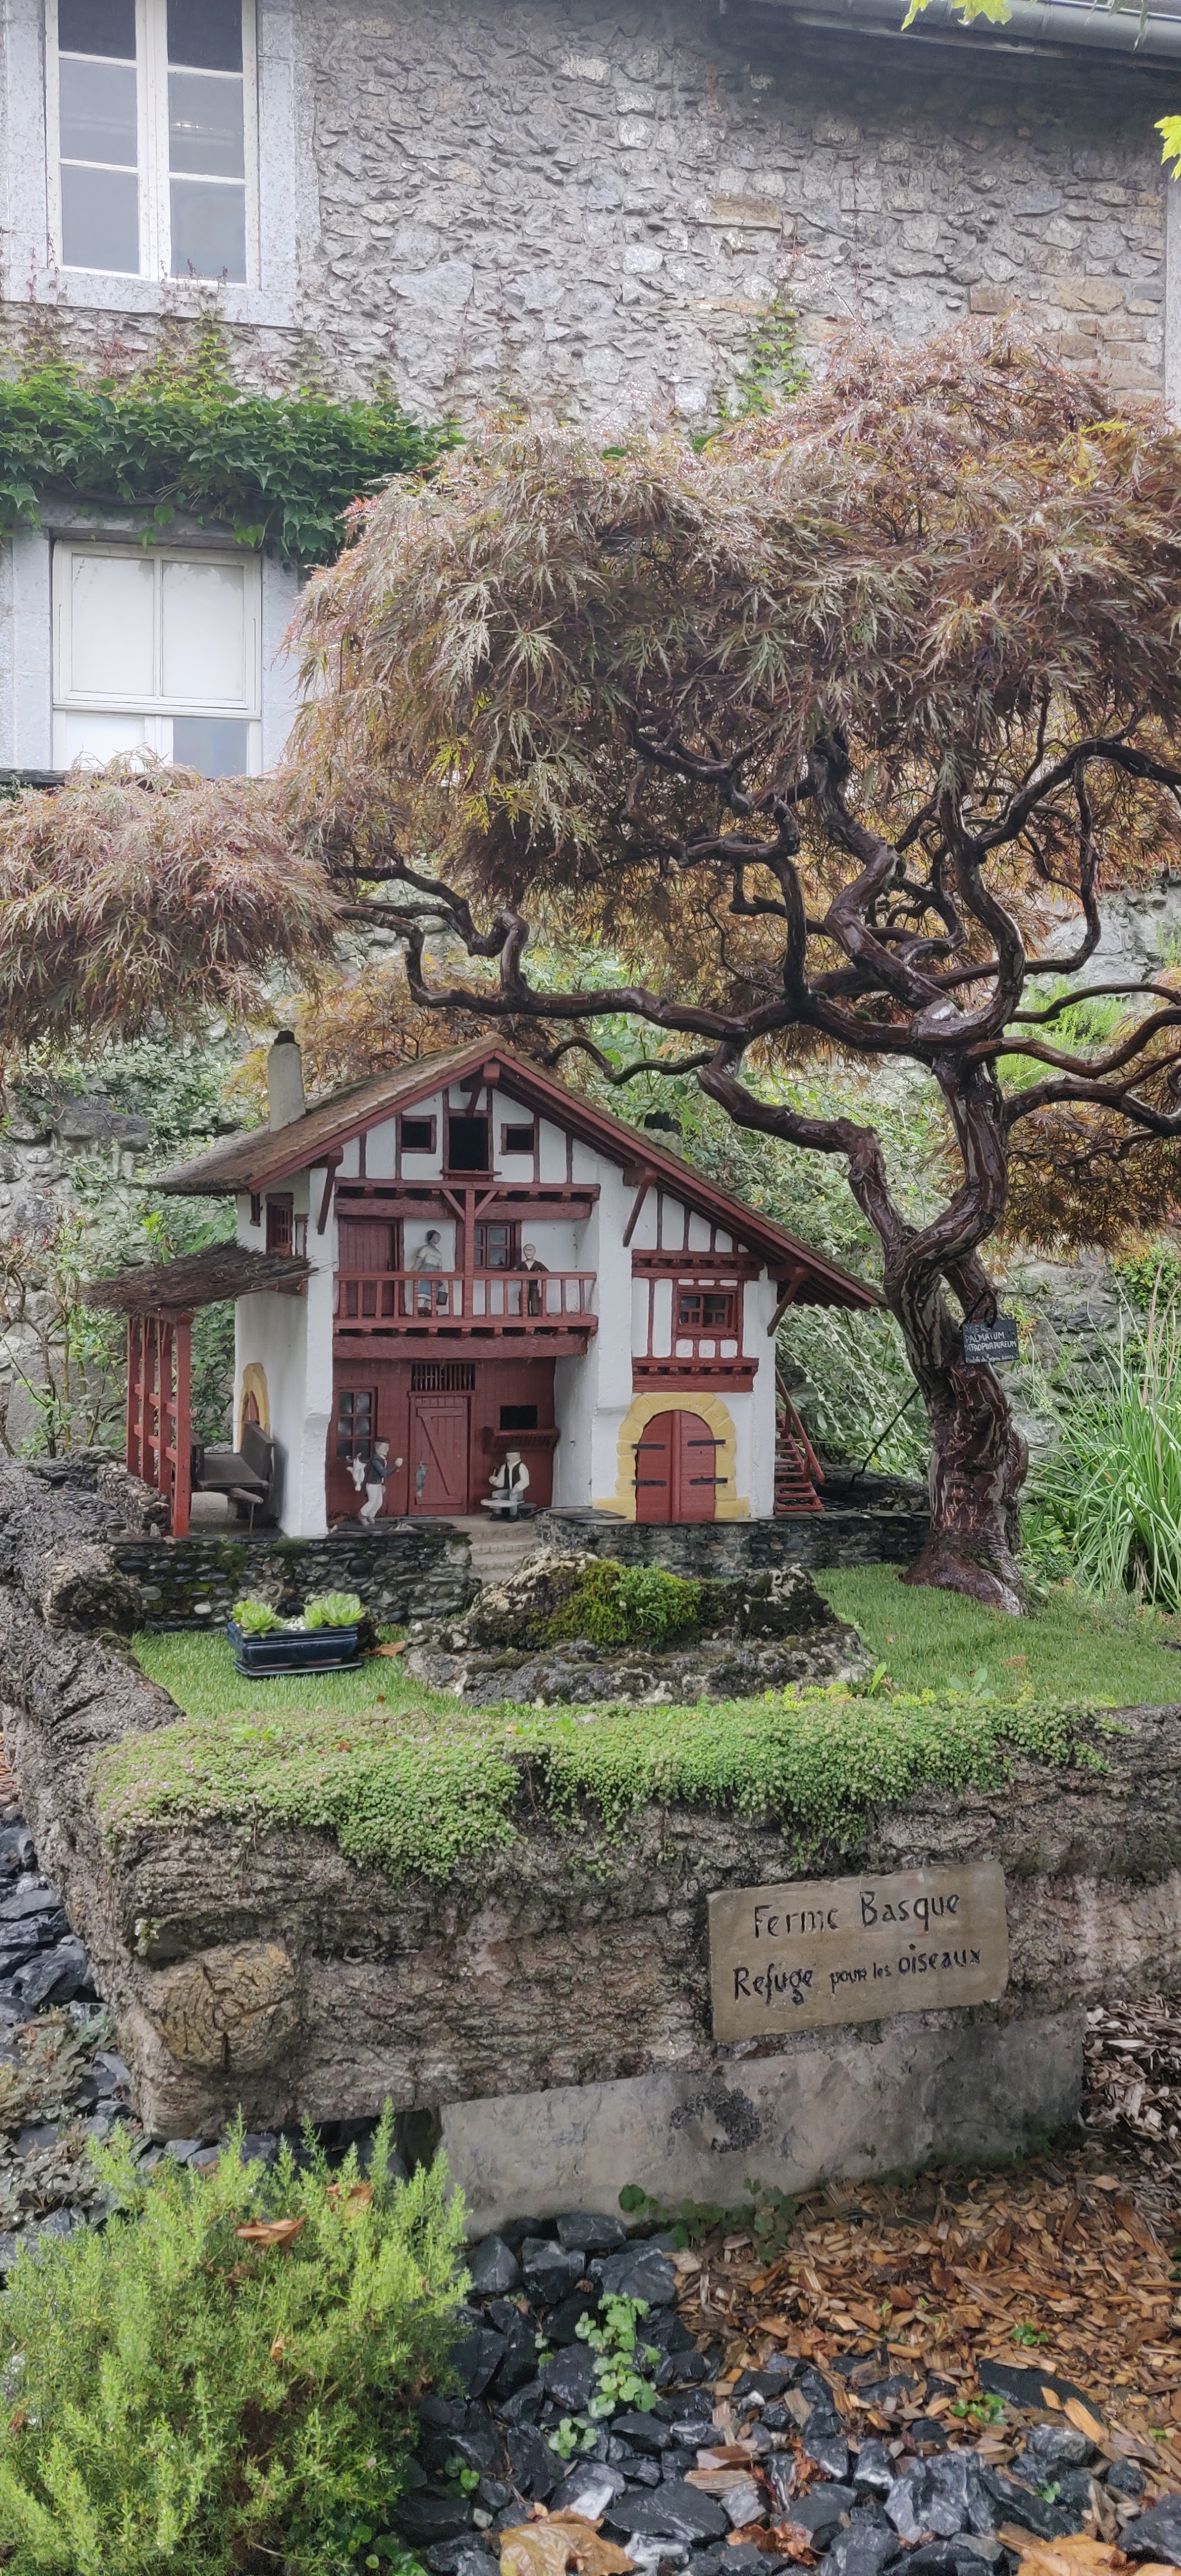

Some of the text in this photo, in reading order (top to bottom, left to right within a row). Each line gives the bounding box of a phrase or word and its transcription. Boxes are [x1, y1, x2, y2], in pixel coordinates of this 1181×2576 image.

[965, 1331, 1005, 1343] PALMATUM
[754, 1891, 961, 1939] Ferme Basque
[733, 1944, 982, 2006] Refuge pour les oiseaux
